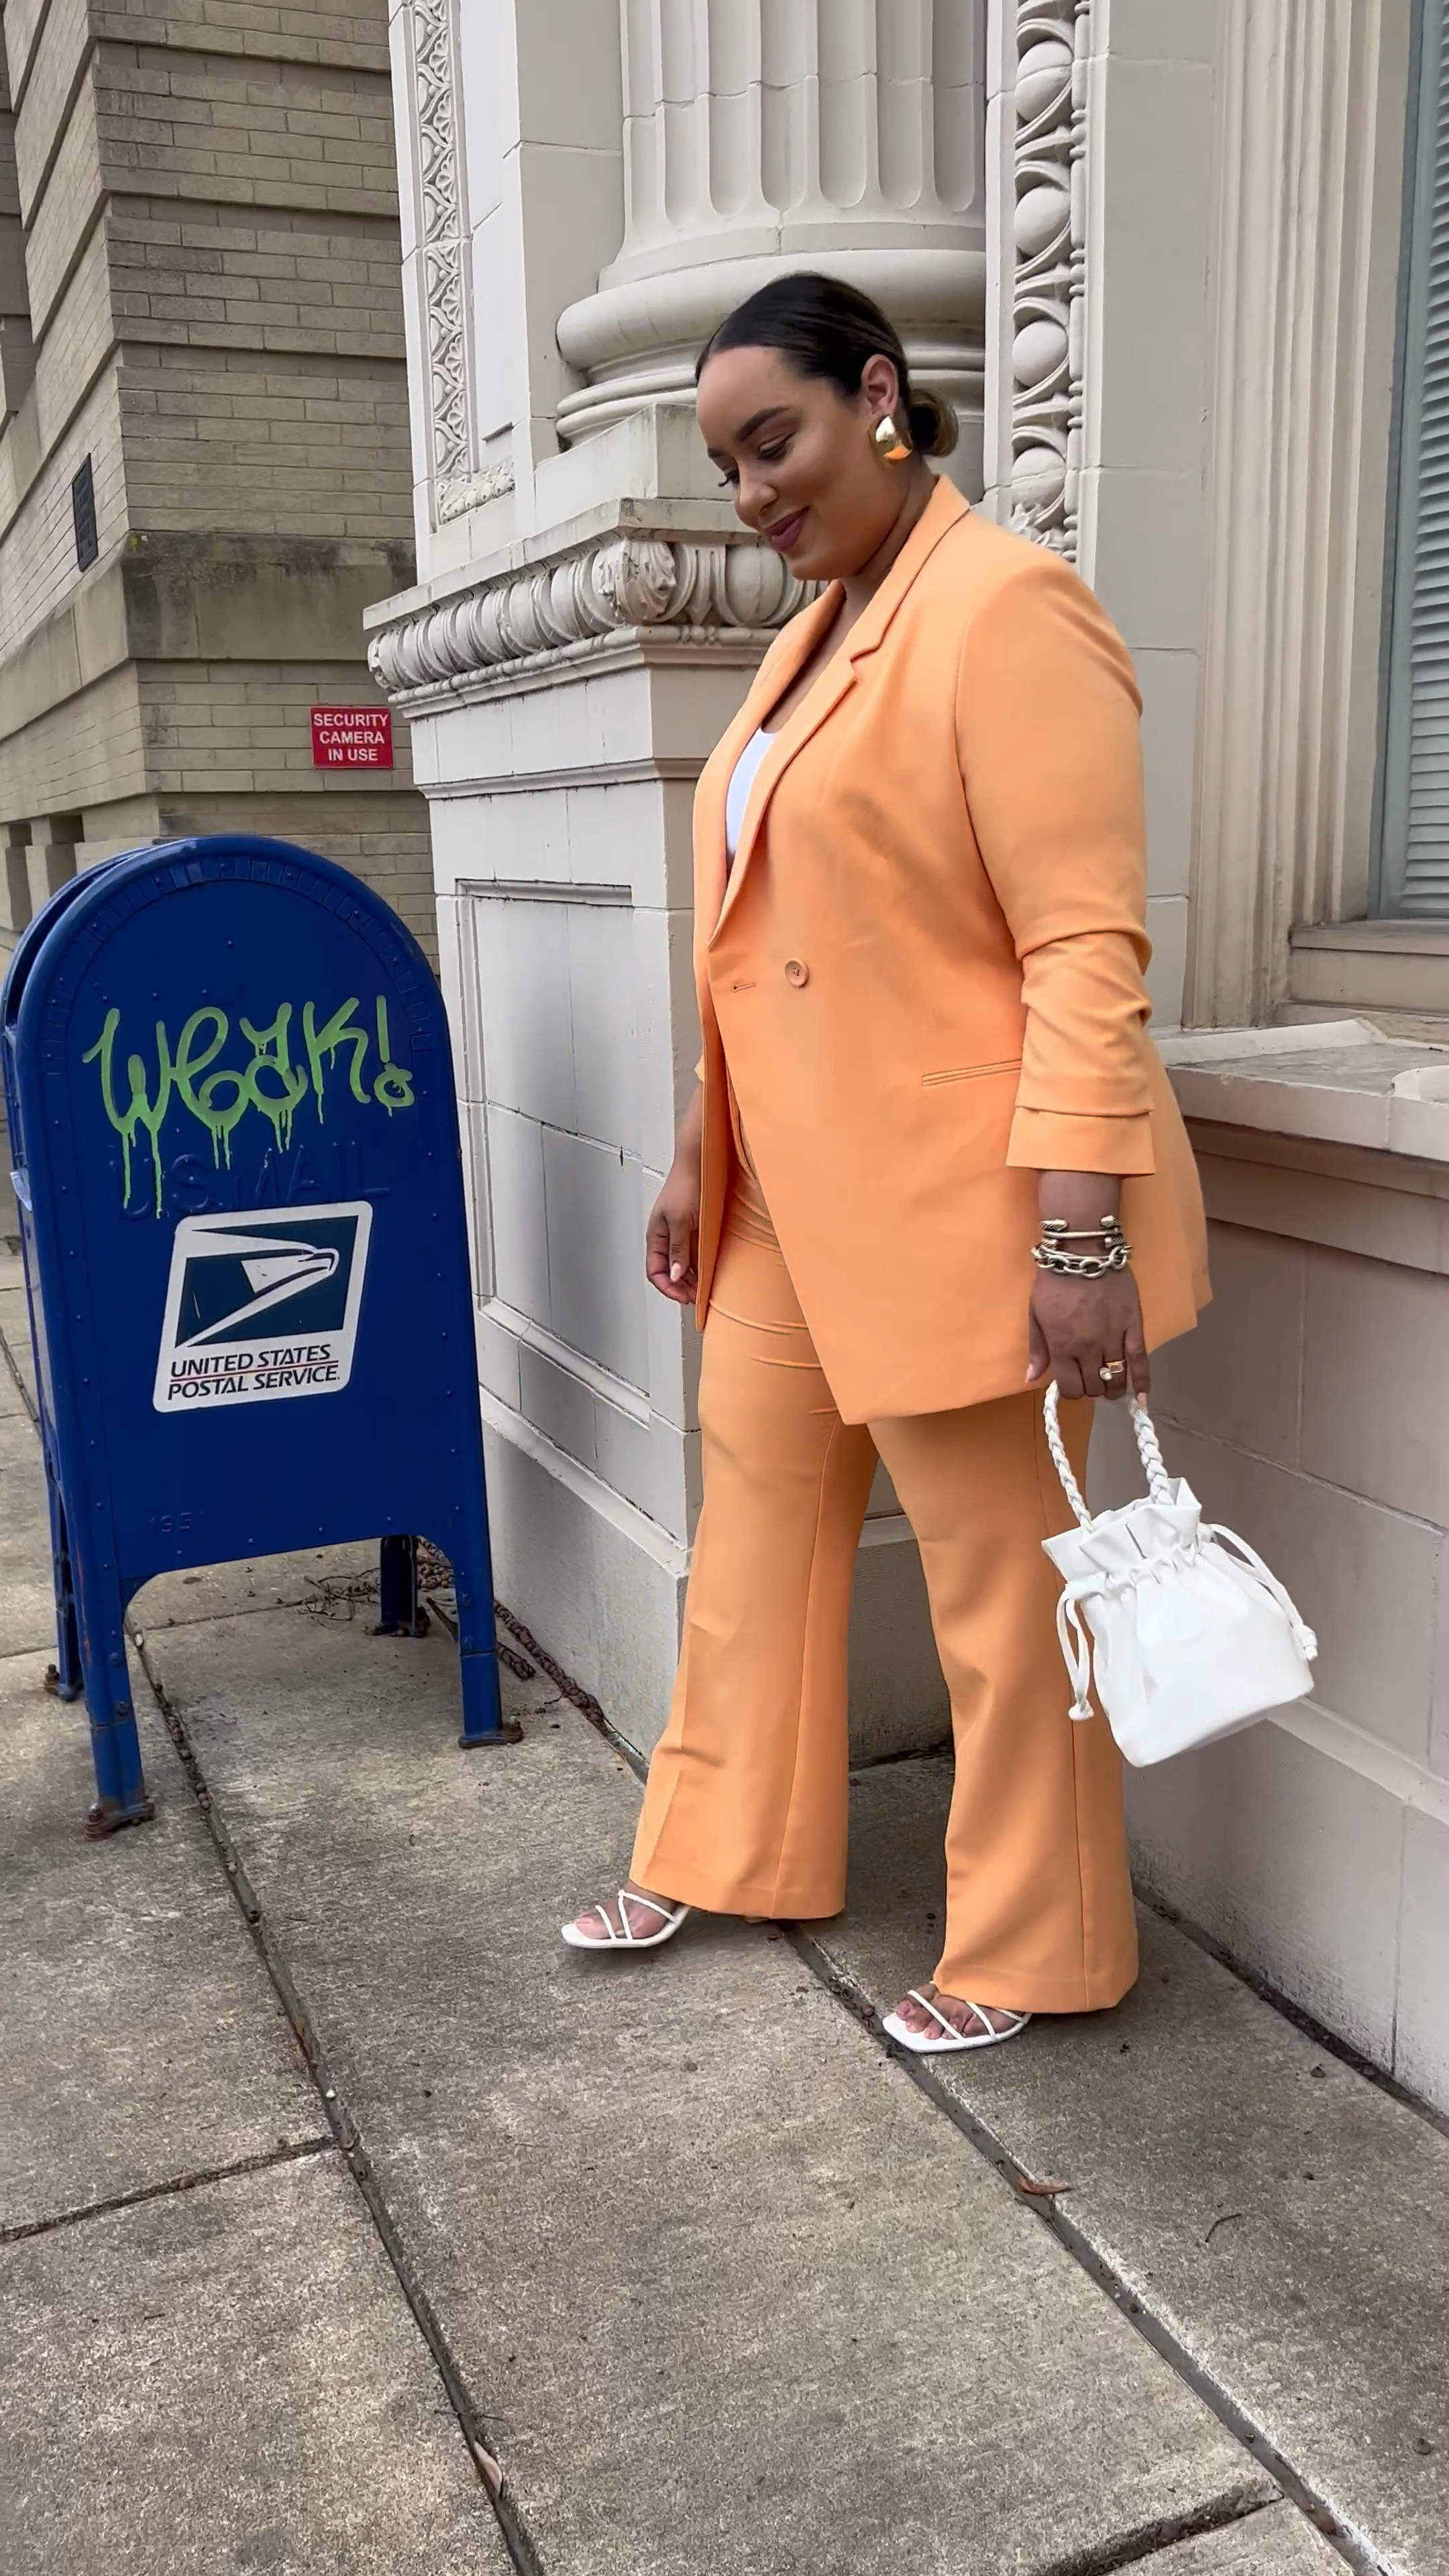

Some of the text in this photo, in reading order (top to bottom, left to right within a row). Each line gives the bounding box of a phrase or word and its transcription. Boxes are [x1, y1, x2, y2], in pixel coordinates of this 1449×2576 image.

[313, 713, 388, 727] SECURITY
[319, 731, 384, 745] CAMERA
[328, 749, 378, 762] IN USE
[170, 1344, 331, 1377] UNITED STATES
[168, 1375, 249, 1401] POSTAL
